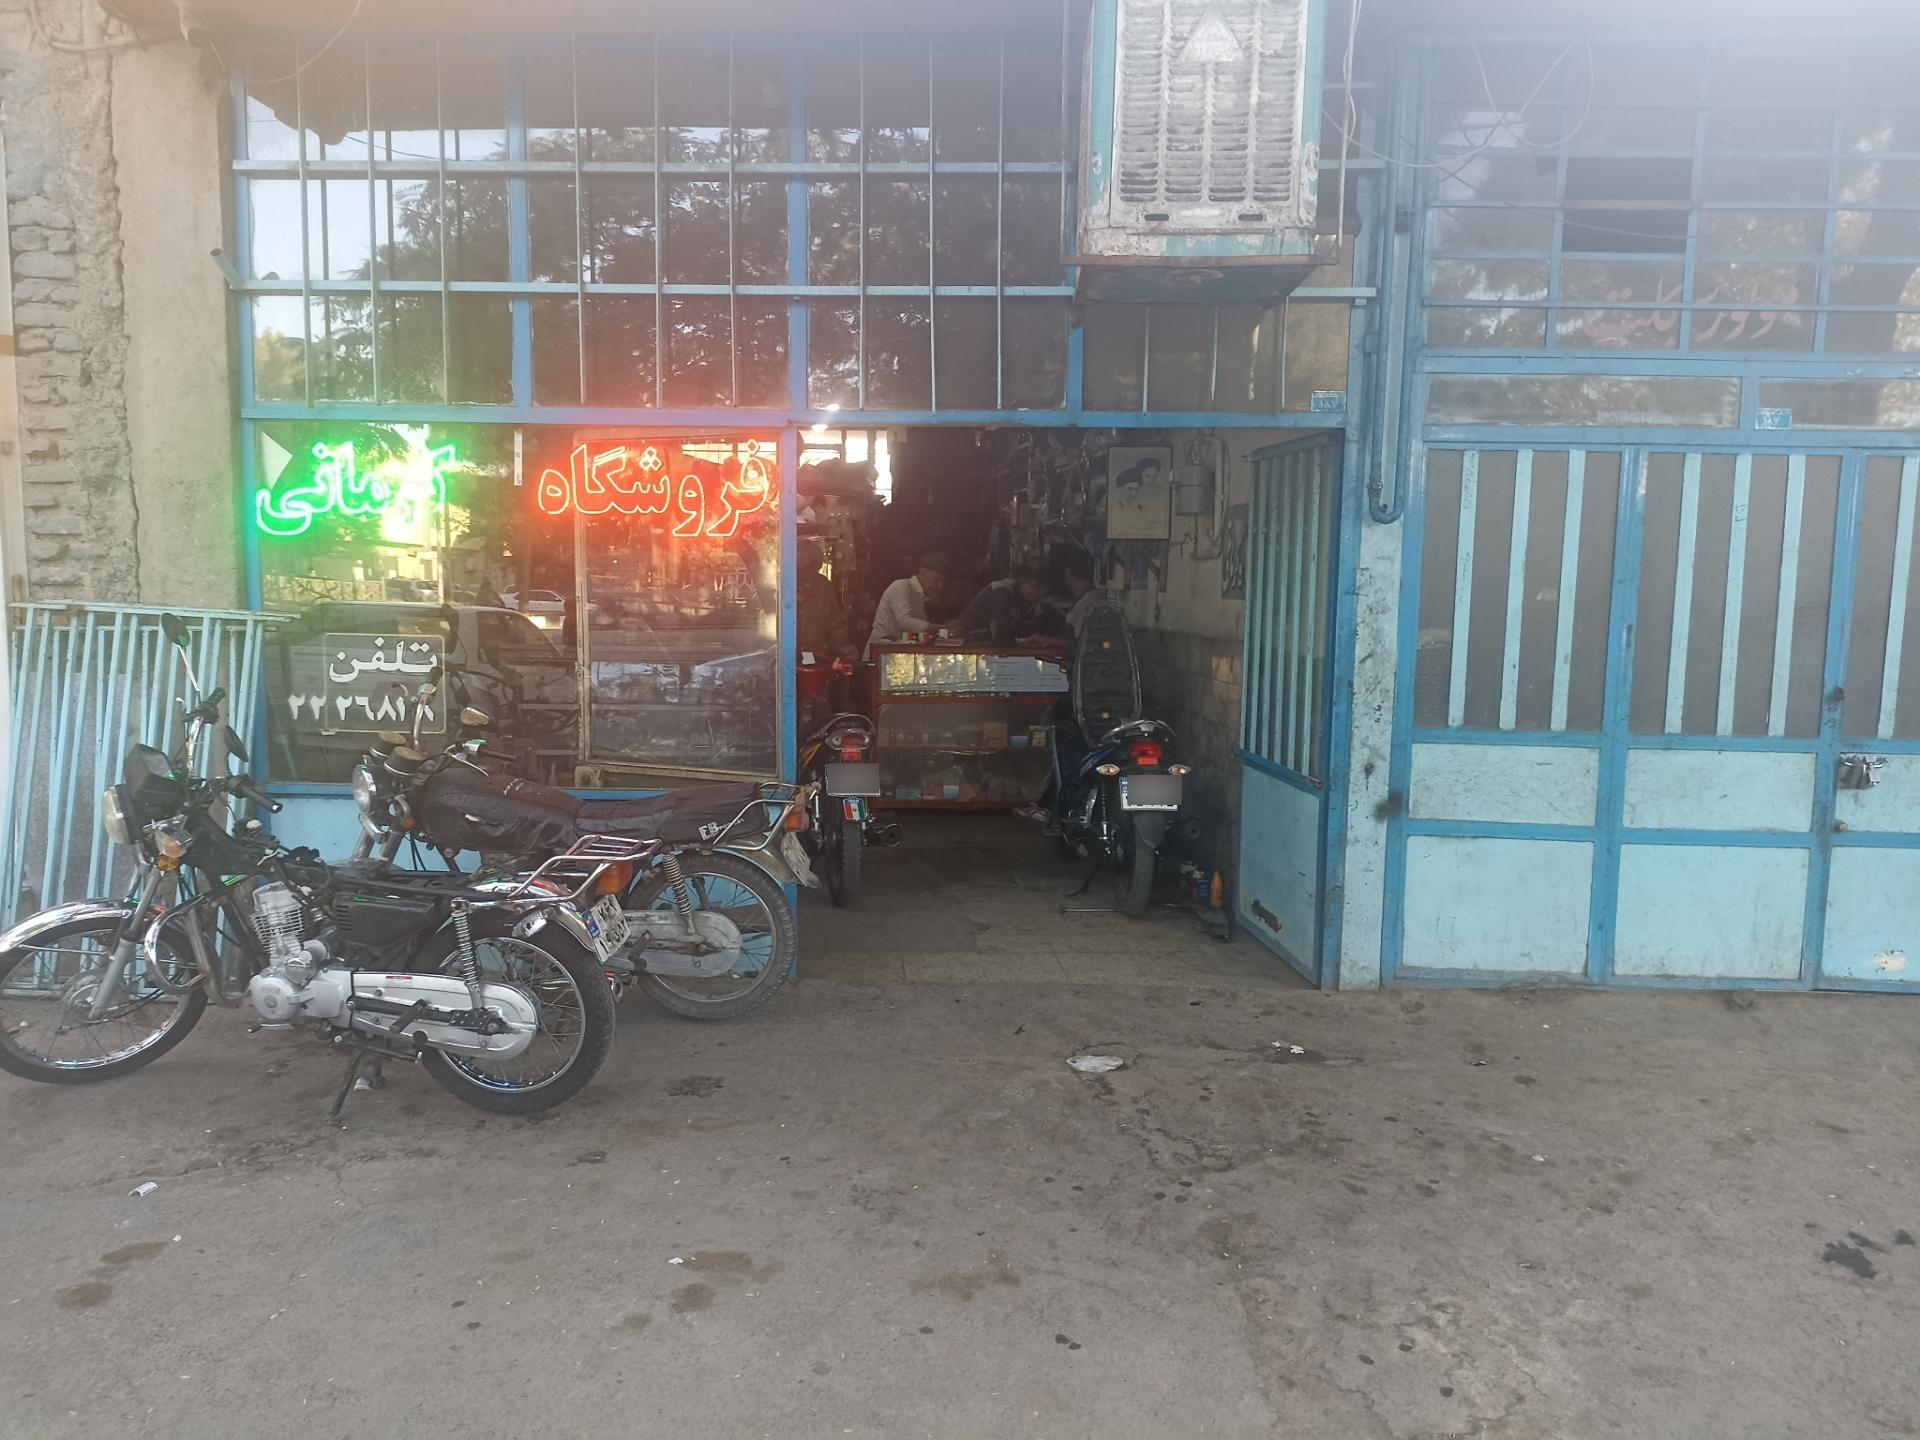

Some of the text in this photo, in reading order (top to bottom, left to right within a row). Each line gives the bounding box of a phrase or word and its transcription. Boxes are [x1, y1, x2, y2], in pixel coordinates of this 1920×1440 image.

[256, 439, 456, 536] کرمانی
[537, 438, 768, 537] فروشگاه
[329, 636, 438, 683] تلفن
